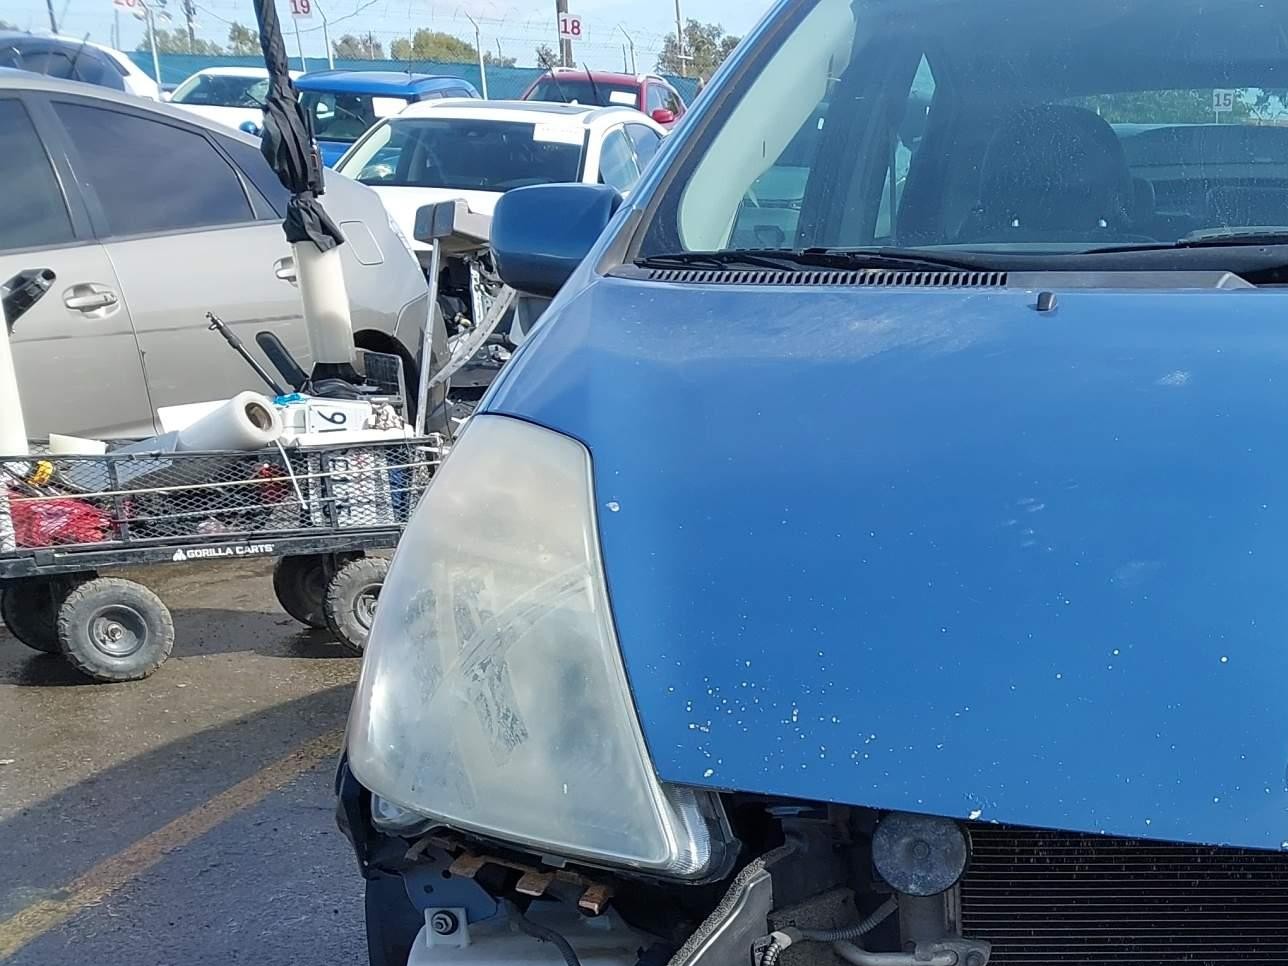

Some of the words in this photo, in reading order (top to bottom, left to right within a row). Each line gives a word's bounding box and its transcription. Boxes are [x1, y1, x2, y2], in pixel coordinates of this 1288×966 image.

[291, 0, 310, 14] 19
[561, 18, 581, 36] 18
[1214, 93, 1232, 107] 15
[186, 547, 234, 559] GORILLA
